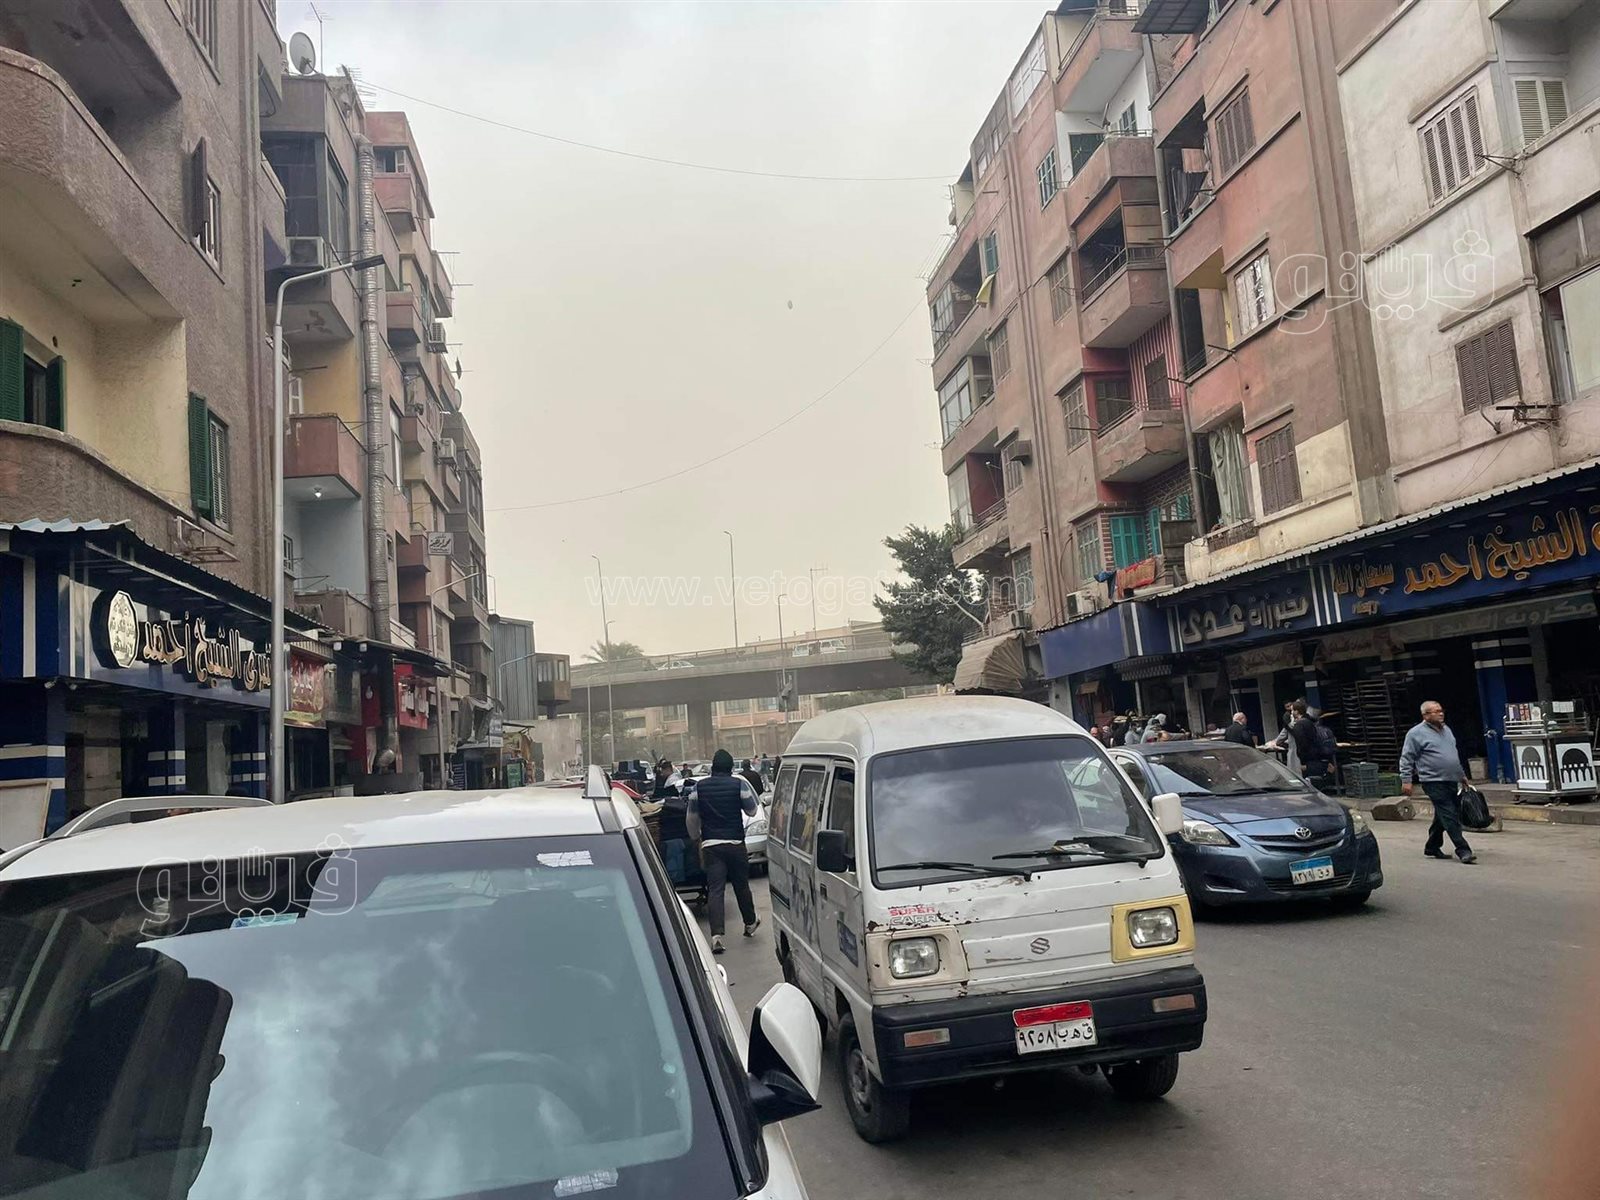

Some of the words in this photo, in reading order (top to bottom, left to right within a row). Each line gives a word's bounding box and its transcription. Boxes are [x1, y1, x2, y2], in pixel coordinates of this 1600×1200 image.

[1484, 507, 1587, 580] الشيخ
[194, 617, 242, 688] الشيخ
[889, 905, 936, 917] SUPER
[1019, 1029, 1054, 1047] ٩٢٥٨
